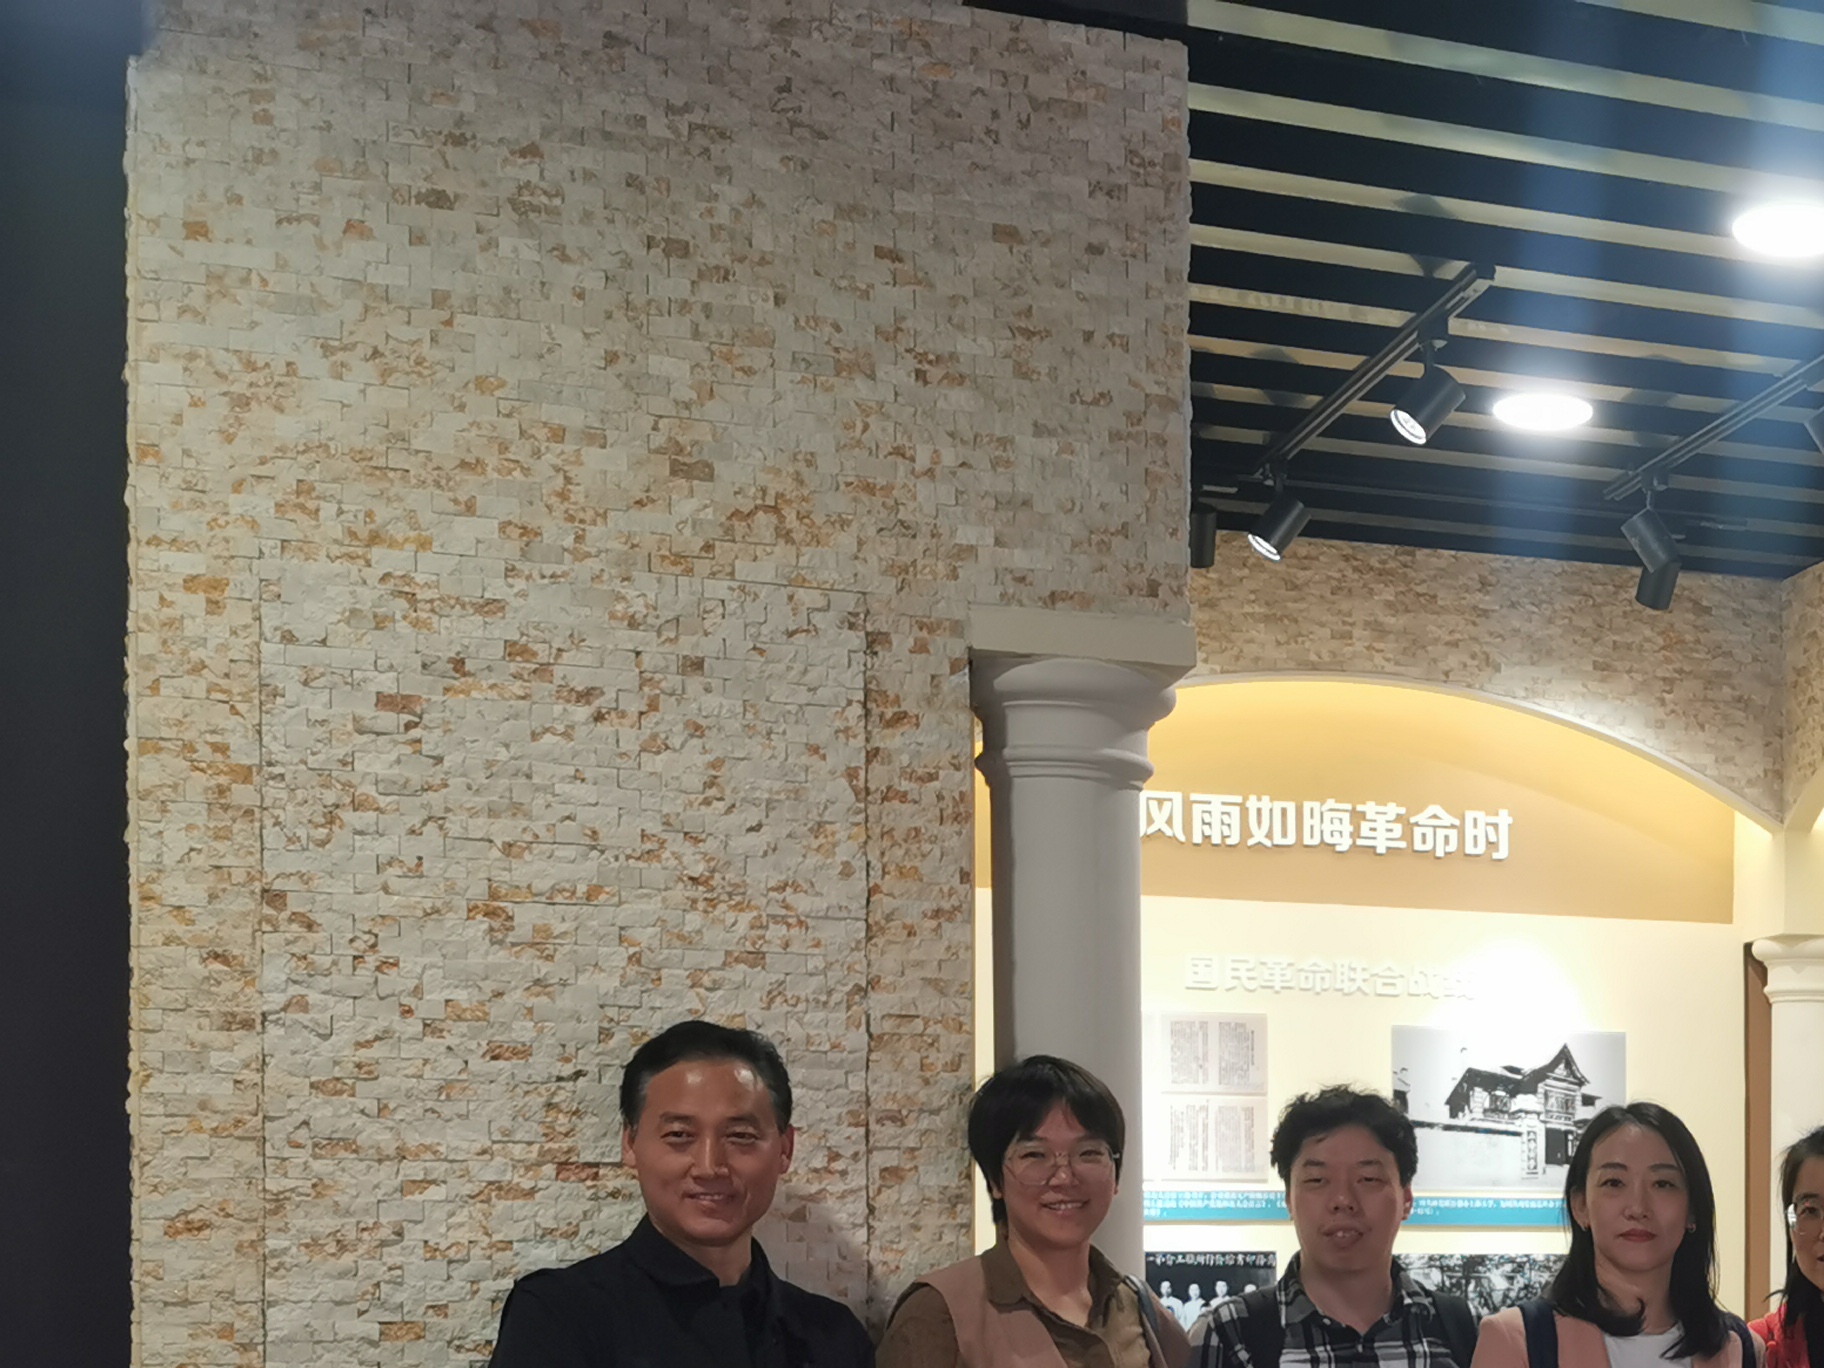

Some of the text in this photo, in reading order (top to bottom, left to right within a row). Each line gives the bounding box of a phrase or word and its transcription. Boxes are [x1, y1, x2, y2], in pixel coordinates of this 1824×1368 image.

[1139, 790, 1513, 860] 风雨如晦革命时
